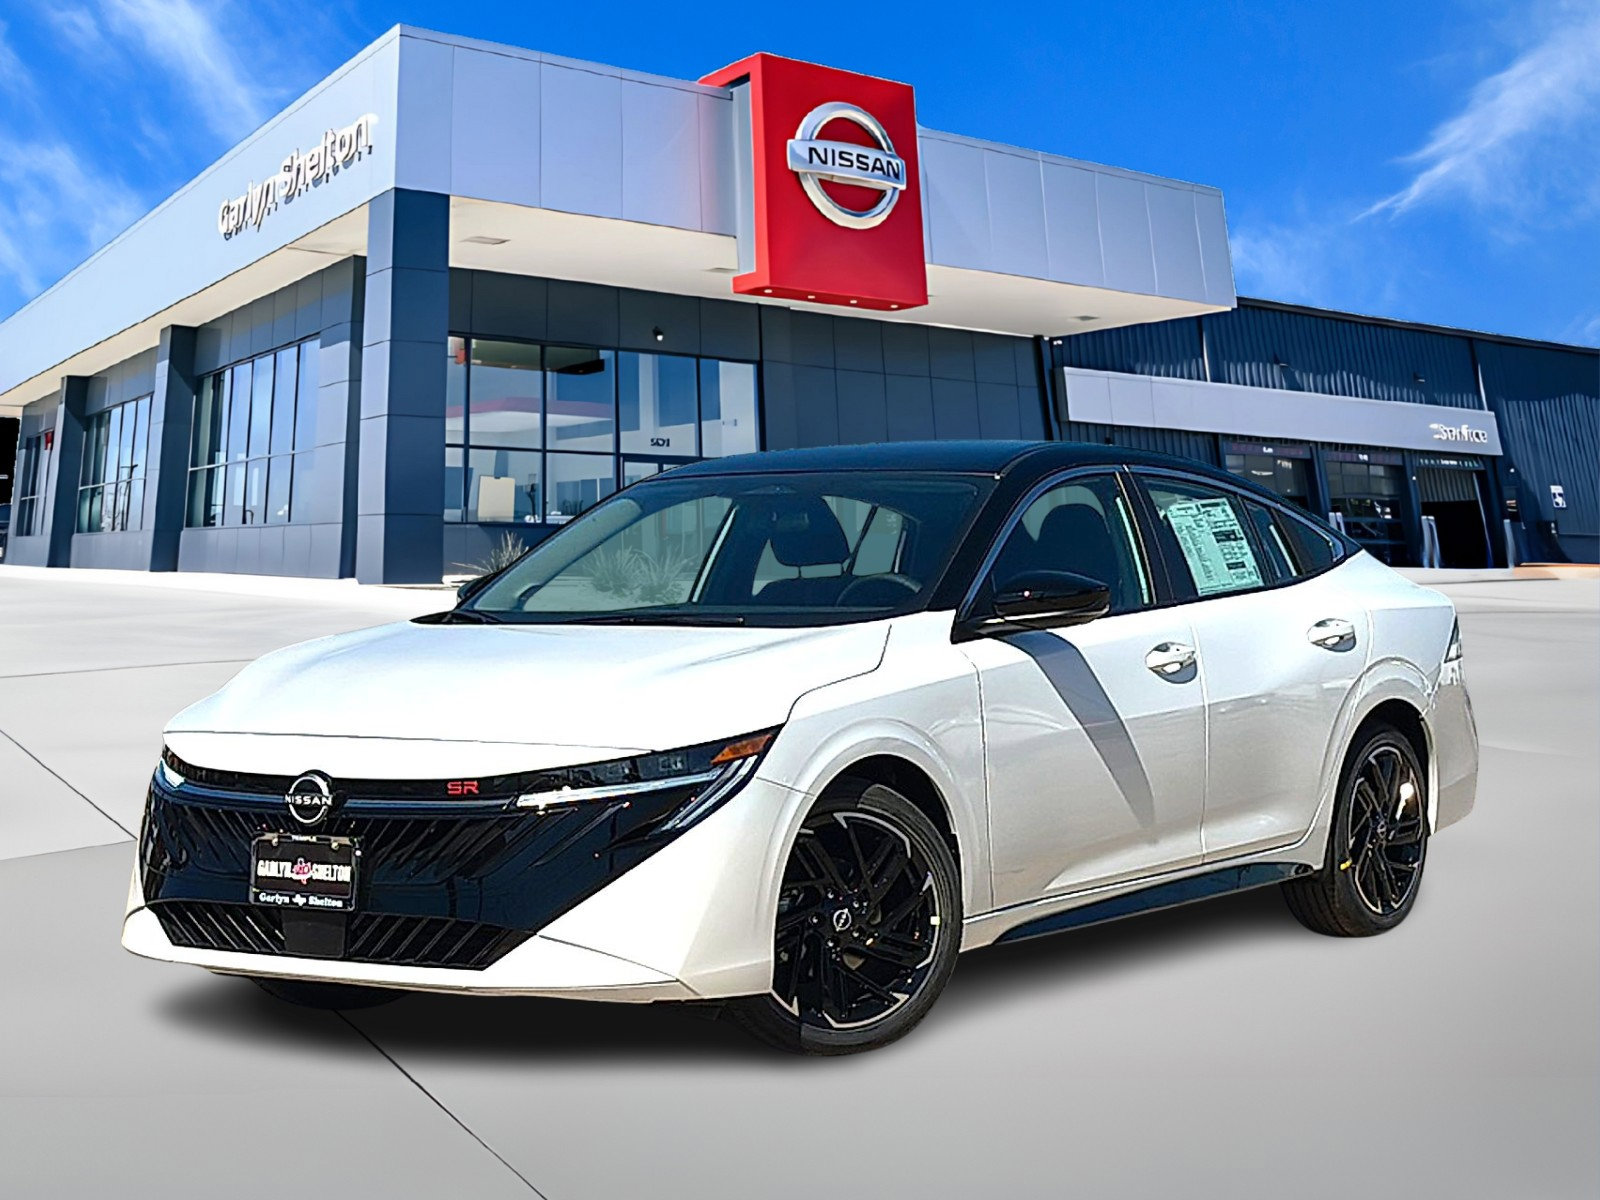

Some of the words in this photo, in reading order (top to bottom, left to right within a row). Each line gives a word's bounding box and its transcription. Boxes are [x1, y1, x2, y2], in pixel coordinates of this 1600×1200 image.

[278, 112, 374, 206] Shelton
[808, 146, 900, 180] NISSAN
[446, 780, 479, 795] SR
[284, 794, 333, 806] NISSAN
